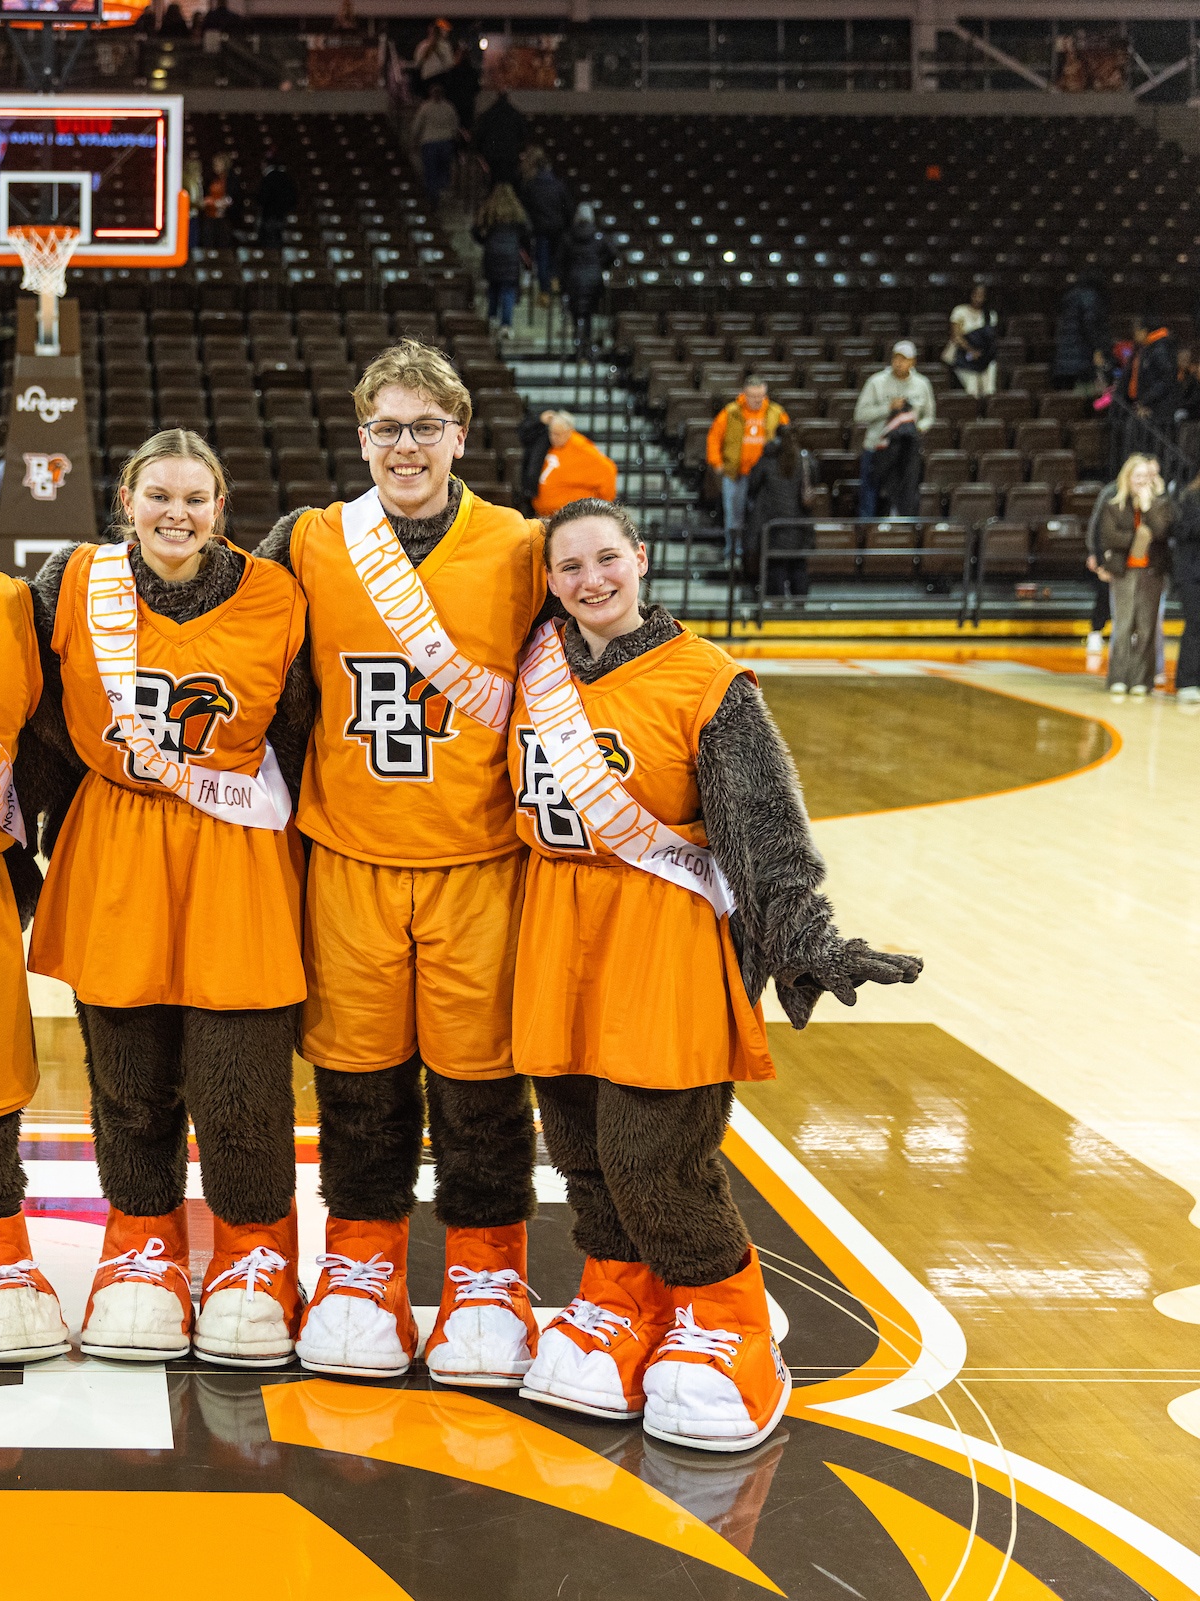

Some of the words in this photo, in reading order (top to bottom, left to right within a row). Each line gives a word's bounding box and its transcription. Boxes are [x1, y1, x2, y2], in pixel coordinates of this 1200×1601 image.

[16, 386, 78, 423] Kroger
[349, 517, 443, 657] FREDDIE
[425, 641, 441, 657] &
[90, 555, 136, 684] FREDDIE
[107, 689, 122, 703] &
[346, 658, 431, 777] BG
[561, 730, 577, 744] &
[198, 779, 252, 808] FALCON
[551, 735, 659, 862] FRIEDA
[652, 846, 714, 887] FALCON
